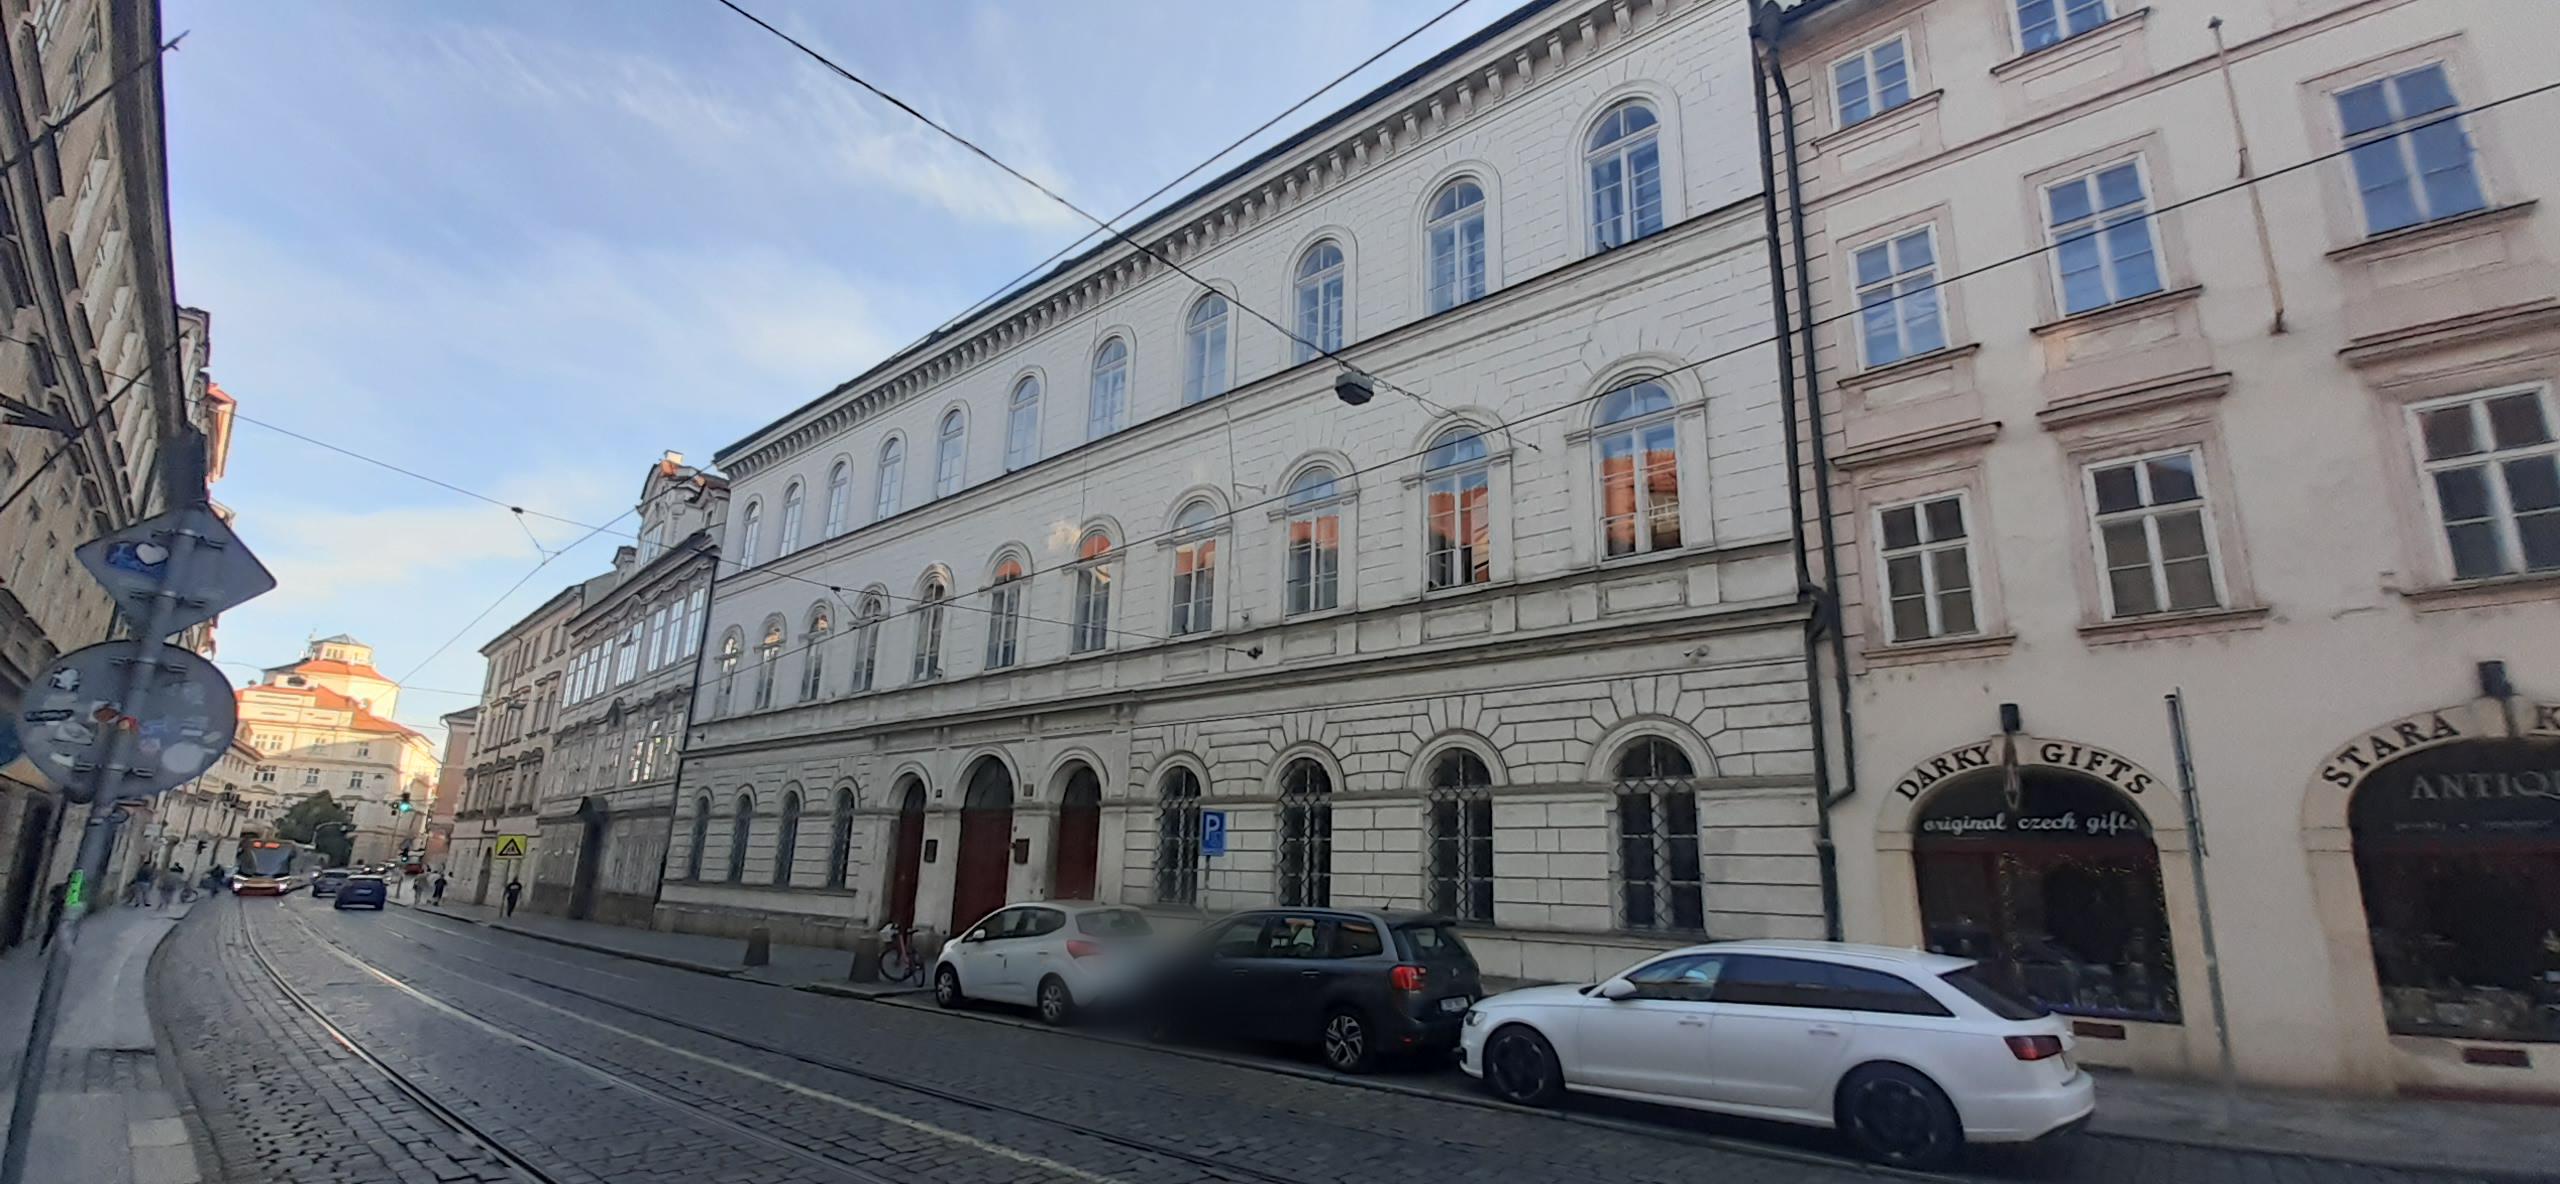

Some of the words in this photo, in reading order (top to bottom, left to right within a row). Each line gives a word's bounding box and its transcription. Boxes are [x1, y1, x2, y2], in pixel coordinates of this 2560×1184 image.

[2040, 744, 2152, 794] GIFTS
[1205, 814, 1221, 840] P
[1923, 812, 2006, 835] original
[2018, 811, 2077, 830] czech
[2086, 811, 2138, 835] gifts
